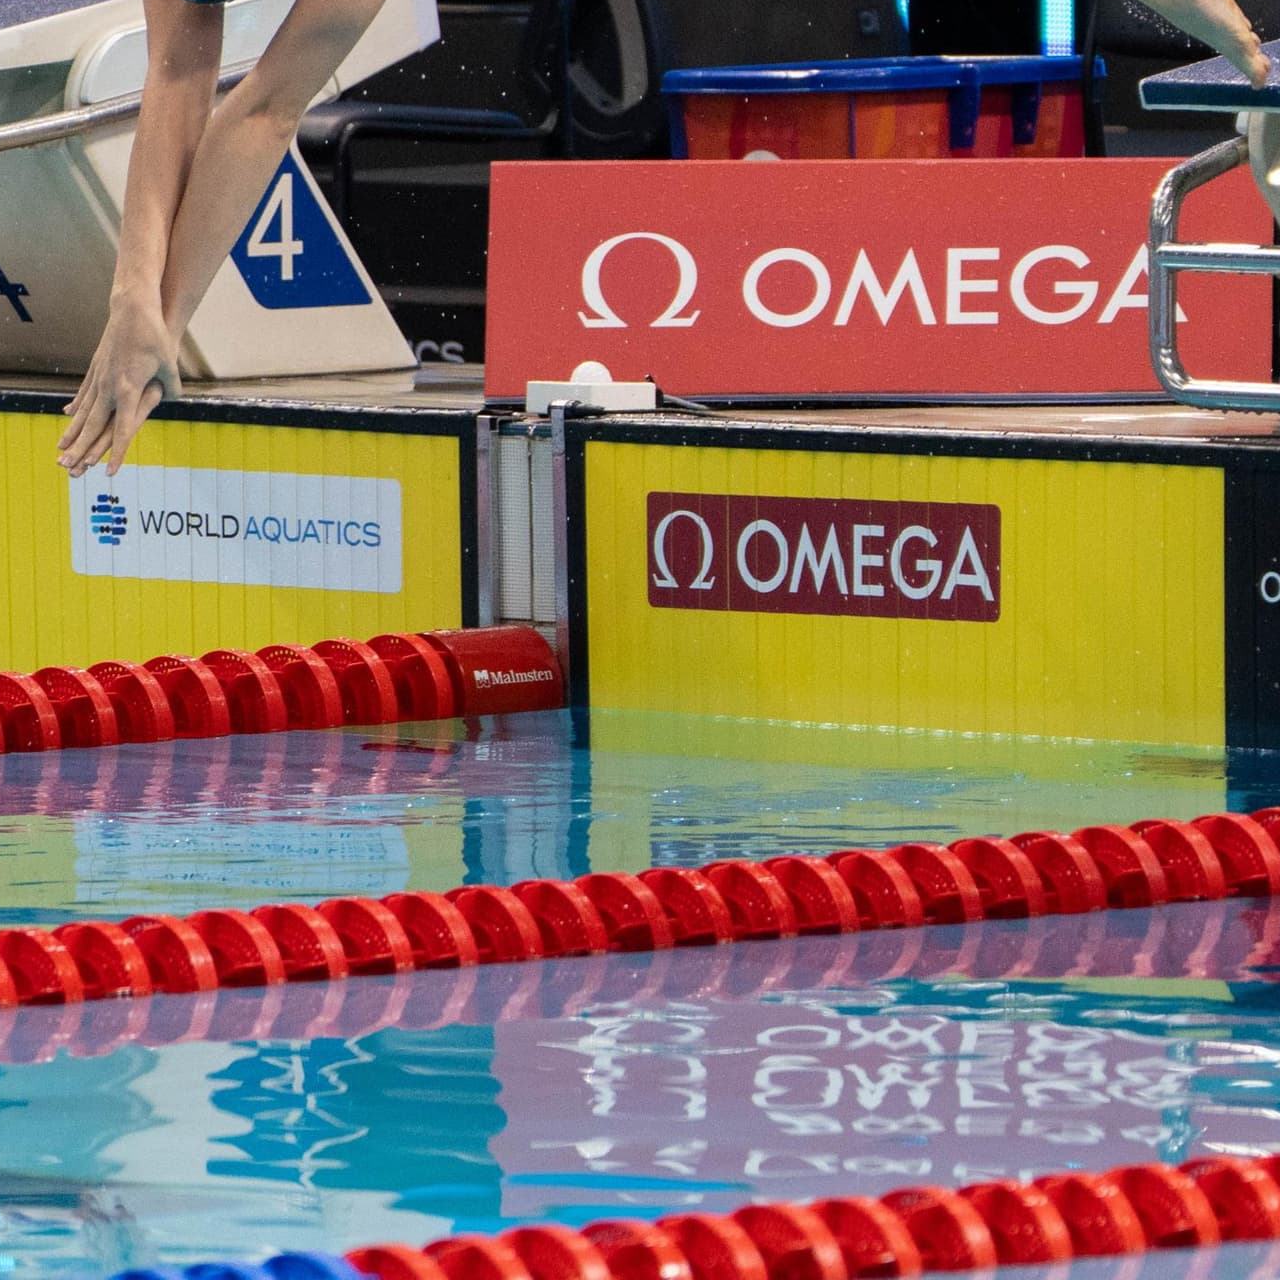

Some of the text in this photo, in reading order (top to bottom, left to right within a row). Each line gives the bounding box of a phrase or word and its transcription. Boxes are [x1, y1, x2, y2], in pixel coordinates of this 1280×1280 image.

[247, 173, 304, 281] 4
[742, 245, 1188, 328] OMEGA
[140, 509, 382, 549] WORLD AQUATICS
[736, 518, 995, 603] OMEGA
[490, 668, 554, 685] Malmsten
